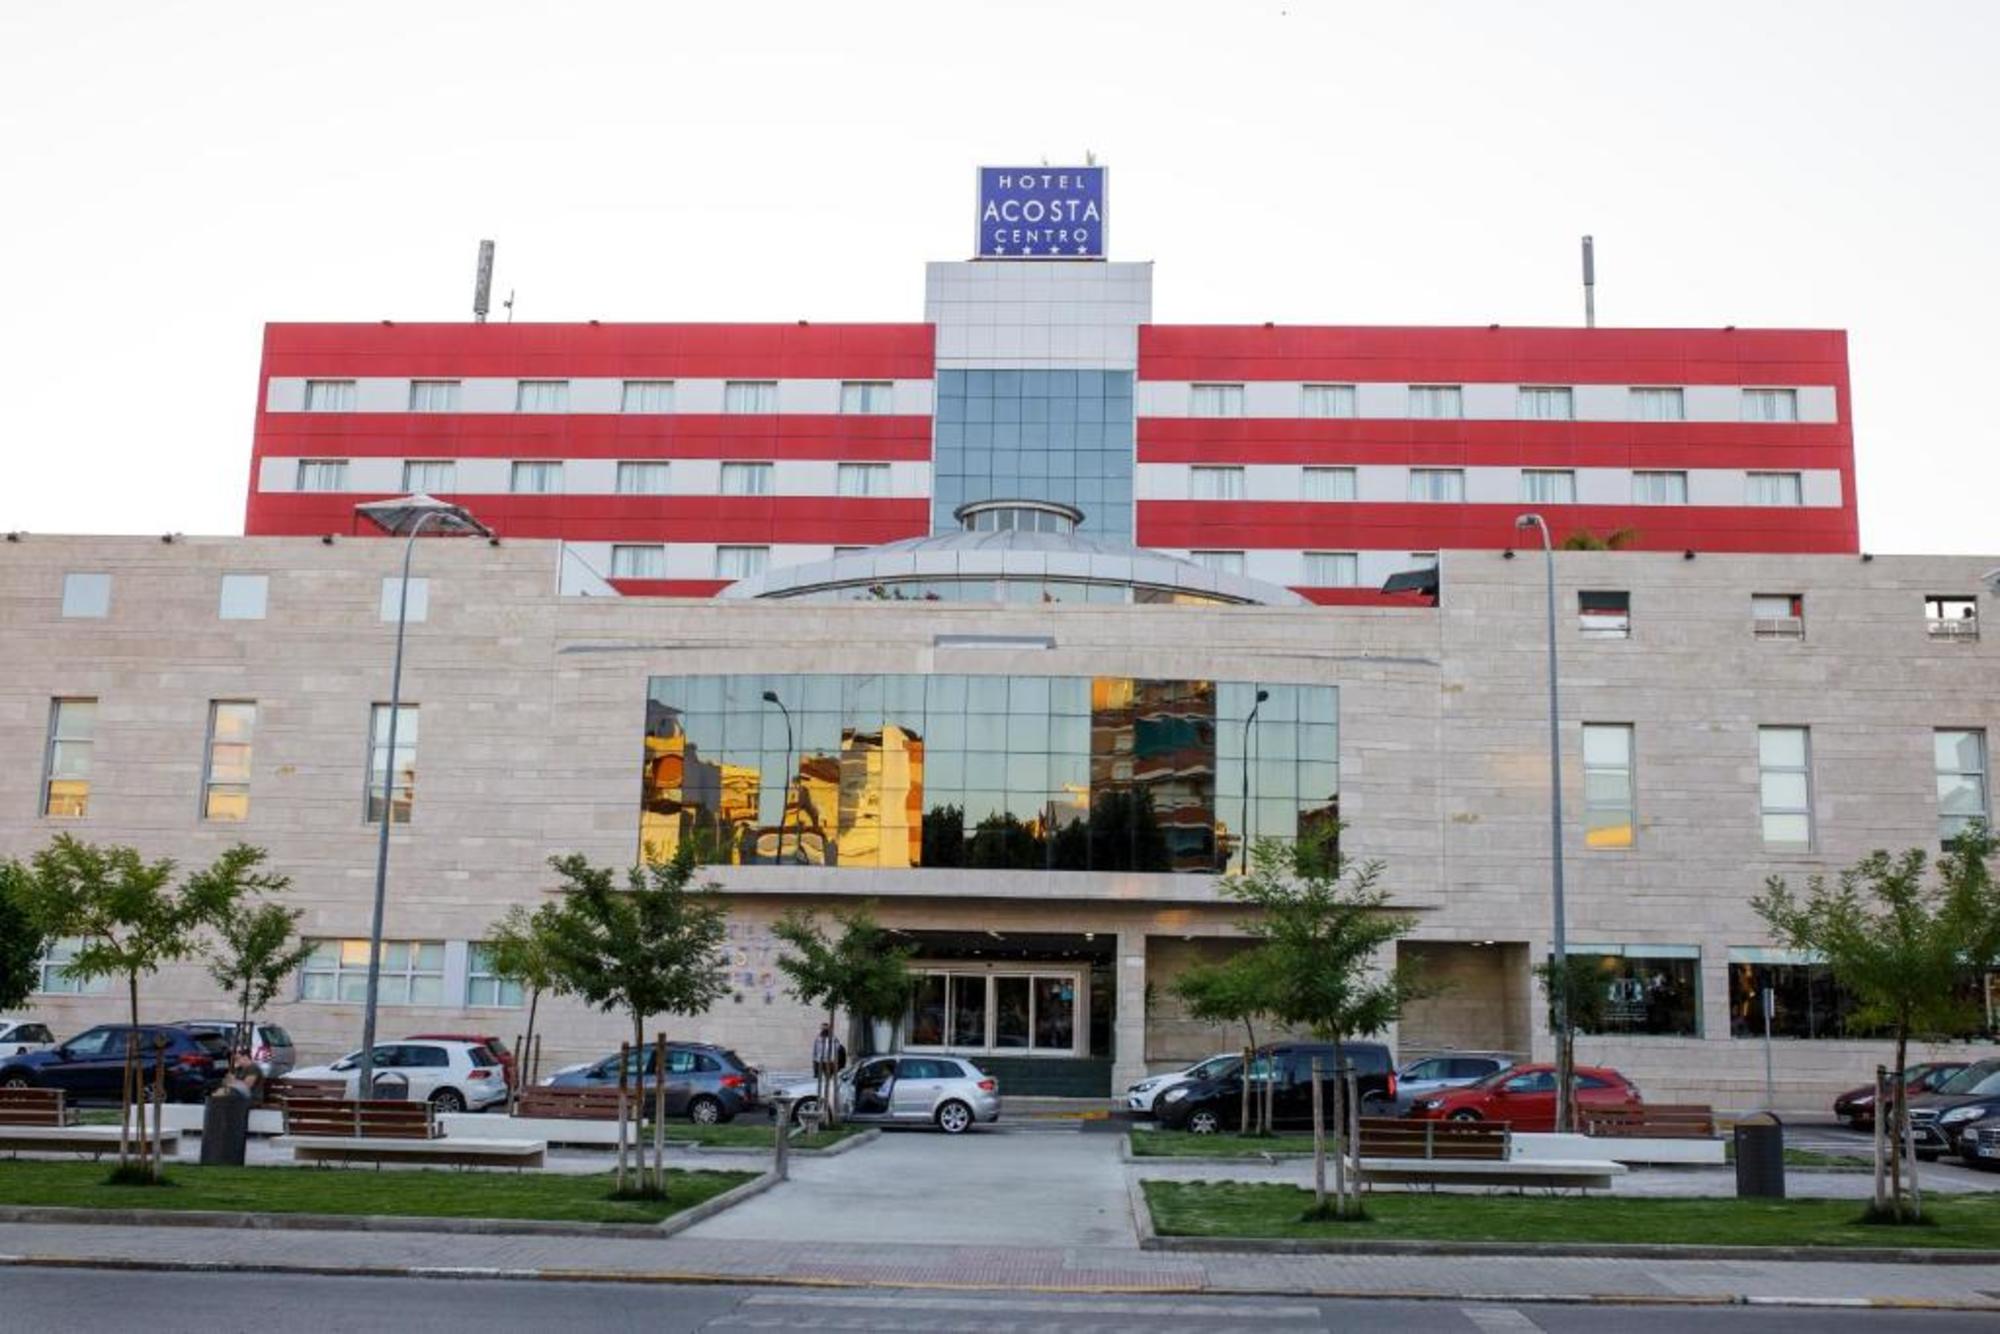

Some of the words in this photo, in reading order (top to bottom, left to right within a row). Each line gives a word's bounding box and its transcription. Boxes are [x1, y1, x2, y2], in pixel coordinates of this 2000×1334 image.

[1000, 175, 1085, 188] HOTEL
[984, 200, 1100, 222] ACOSTA
[995, 229, 1088, 243] CENTRO
